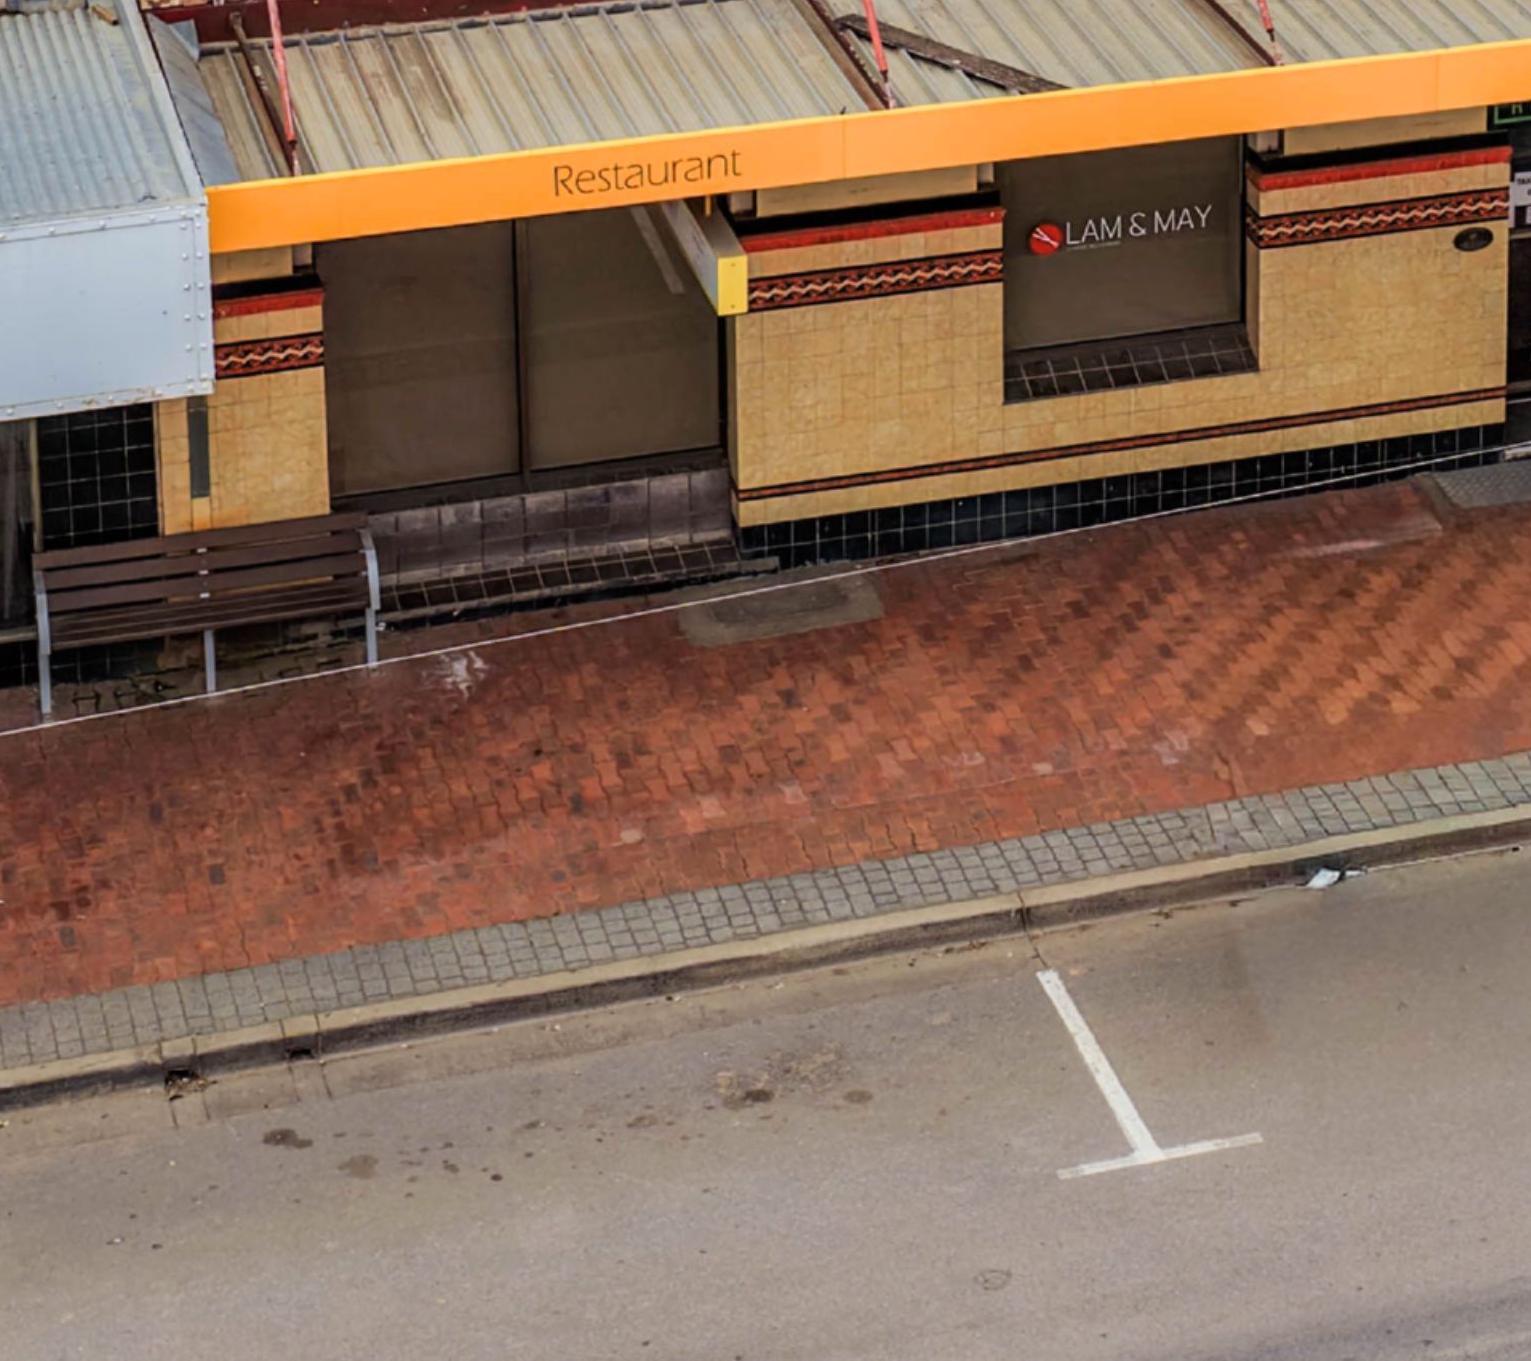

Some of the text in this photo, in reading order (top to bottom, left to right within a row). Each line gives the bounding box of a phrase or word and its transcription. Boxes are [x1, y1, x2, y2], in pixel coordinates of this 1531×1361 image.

[553, 149, 742, 197] Restaurant
[1065, 204, 1213, 245] LAM & MAY
